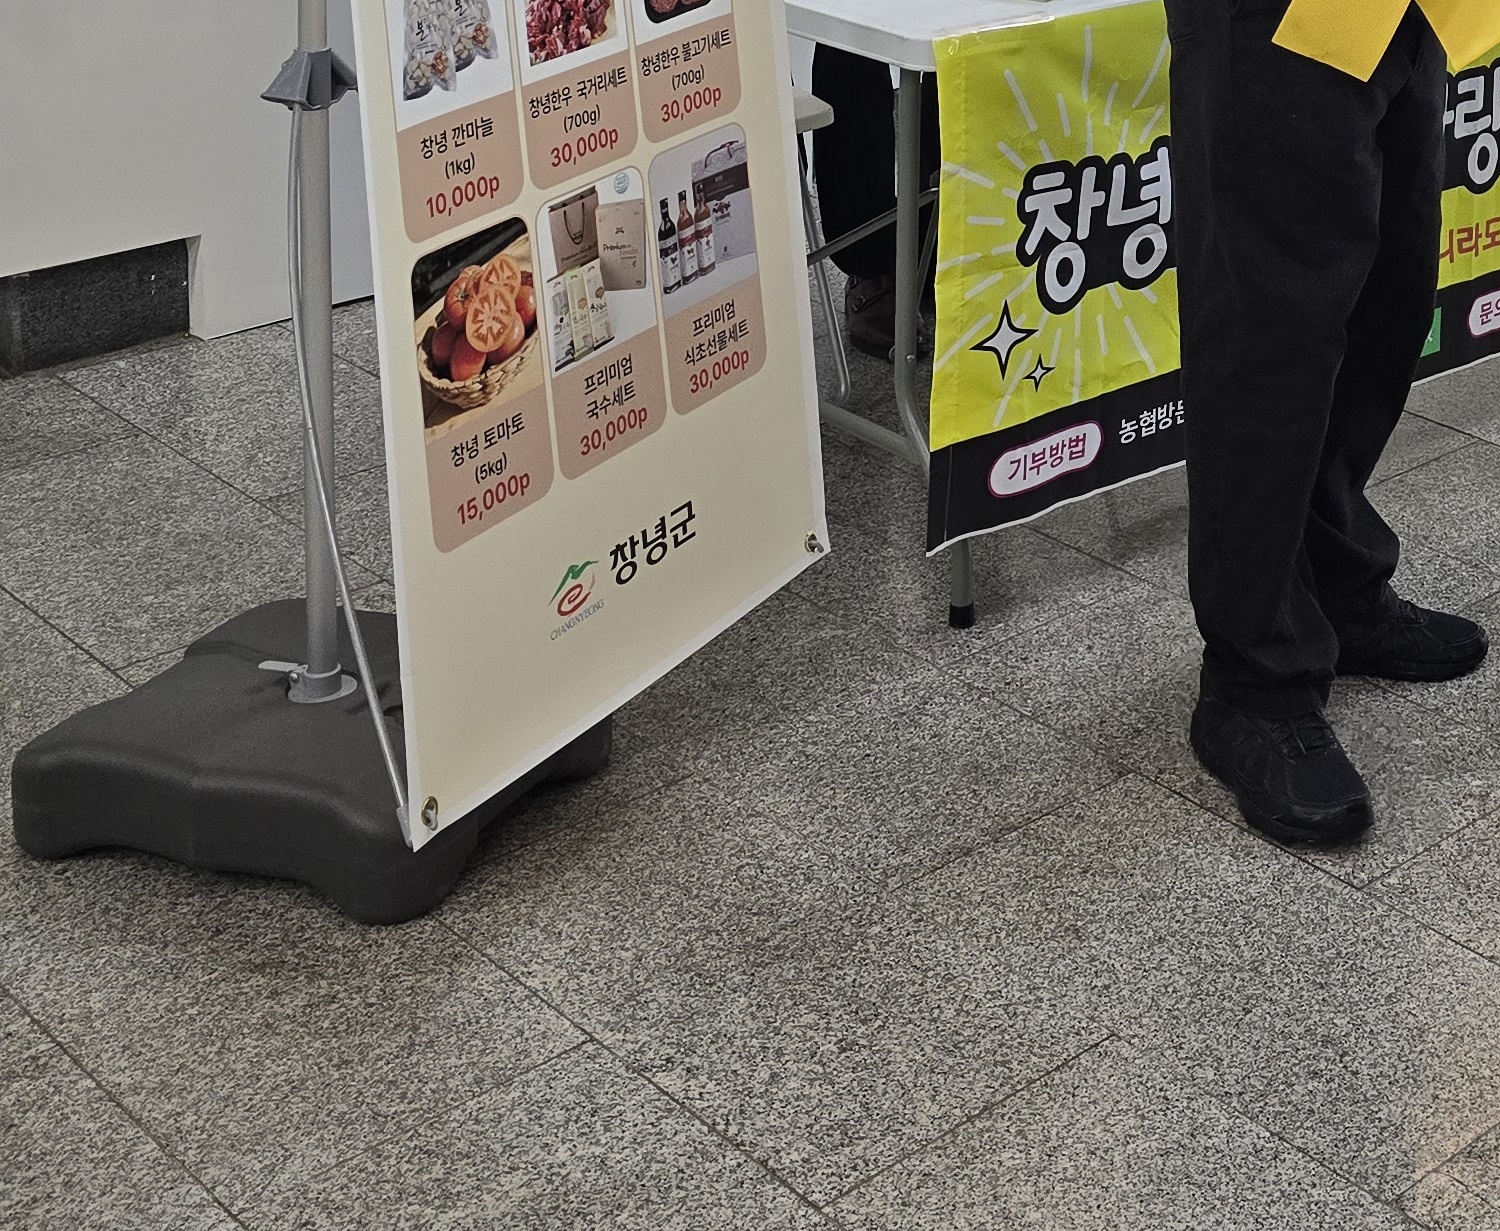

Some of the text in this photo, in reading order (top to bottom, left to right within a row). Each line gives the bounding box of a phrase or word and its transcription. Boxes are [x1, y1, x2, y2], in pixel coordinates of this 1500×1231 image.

[640, 27, 732, 76] 창녕한우 불고기세트
[529, 66, 628, 119] 창녕한우 국거리세트
[671, 64, 705, 91] (700g)
[563, 104, 601, 134] (700g)
[660, 86, 722, 124] 30,000p
[420, 115, 494, 160] 창녕 깐마늘
[551, 126, 619, 169] 30,000p
[444, 152, 476, 178] (1kg)
[426, 174, 500, 219] 10,000p
[1025, 146, 1172, 303] 창녕
[692, 298, 737, 338] 프리미엄
[684, 319, 750, 366] 식초선물세트
[583, 353, 633, 396] 프리미엄
[689, 347, 750, 395] 30,000p
[586, 381, 637, 421] 국수세트
[451, 412, 526, 468] 창녕 토마토
[580, 404, 648, 458] 30,000p
[474, 450, 508, 486] (5kg)
[1007, 432, 1087, 482] 기부방법
[456, 469, 531, 526] 15,000p
[609, 499, 697, 586] 창녕군
